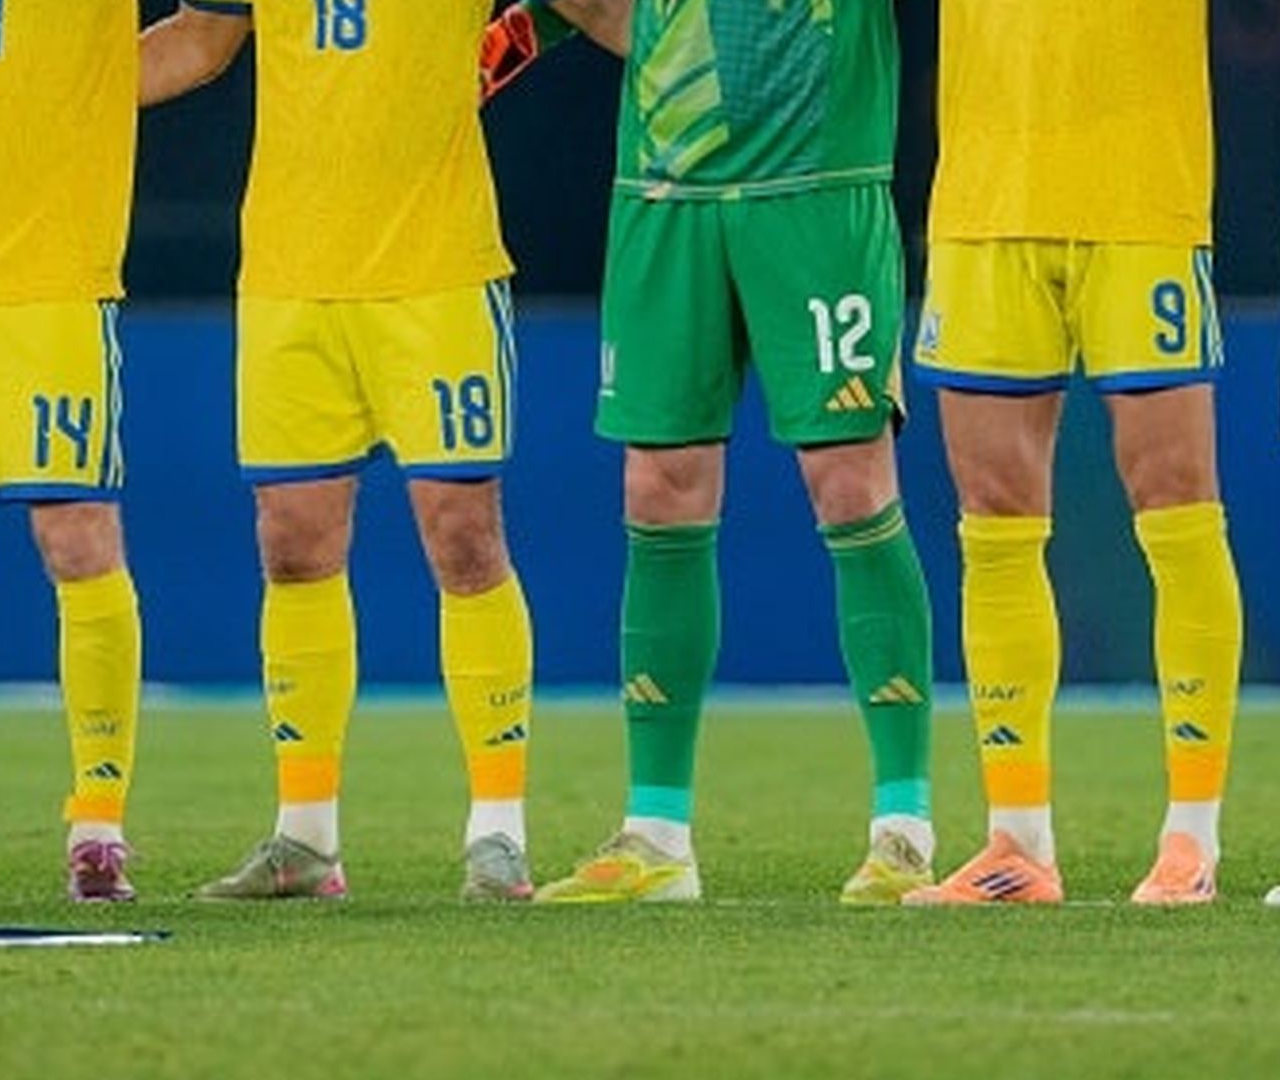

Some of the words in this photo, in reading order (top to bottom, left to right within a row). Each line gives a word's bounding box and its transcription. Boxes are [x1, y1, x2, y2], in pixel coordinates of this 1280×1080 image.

[808, 294, 876, 375] 12
[1151, 280, 1188, 356] 9
[32, 394, 94, 471] 14
[431, 374, 496, 452] 18
